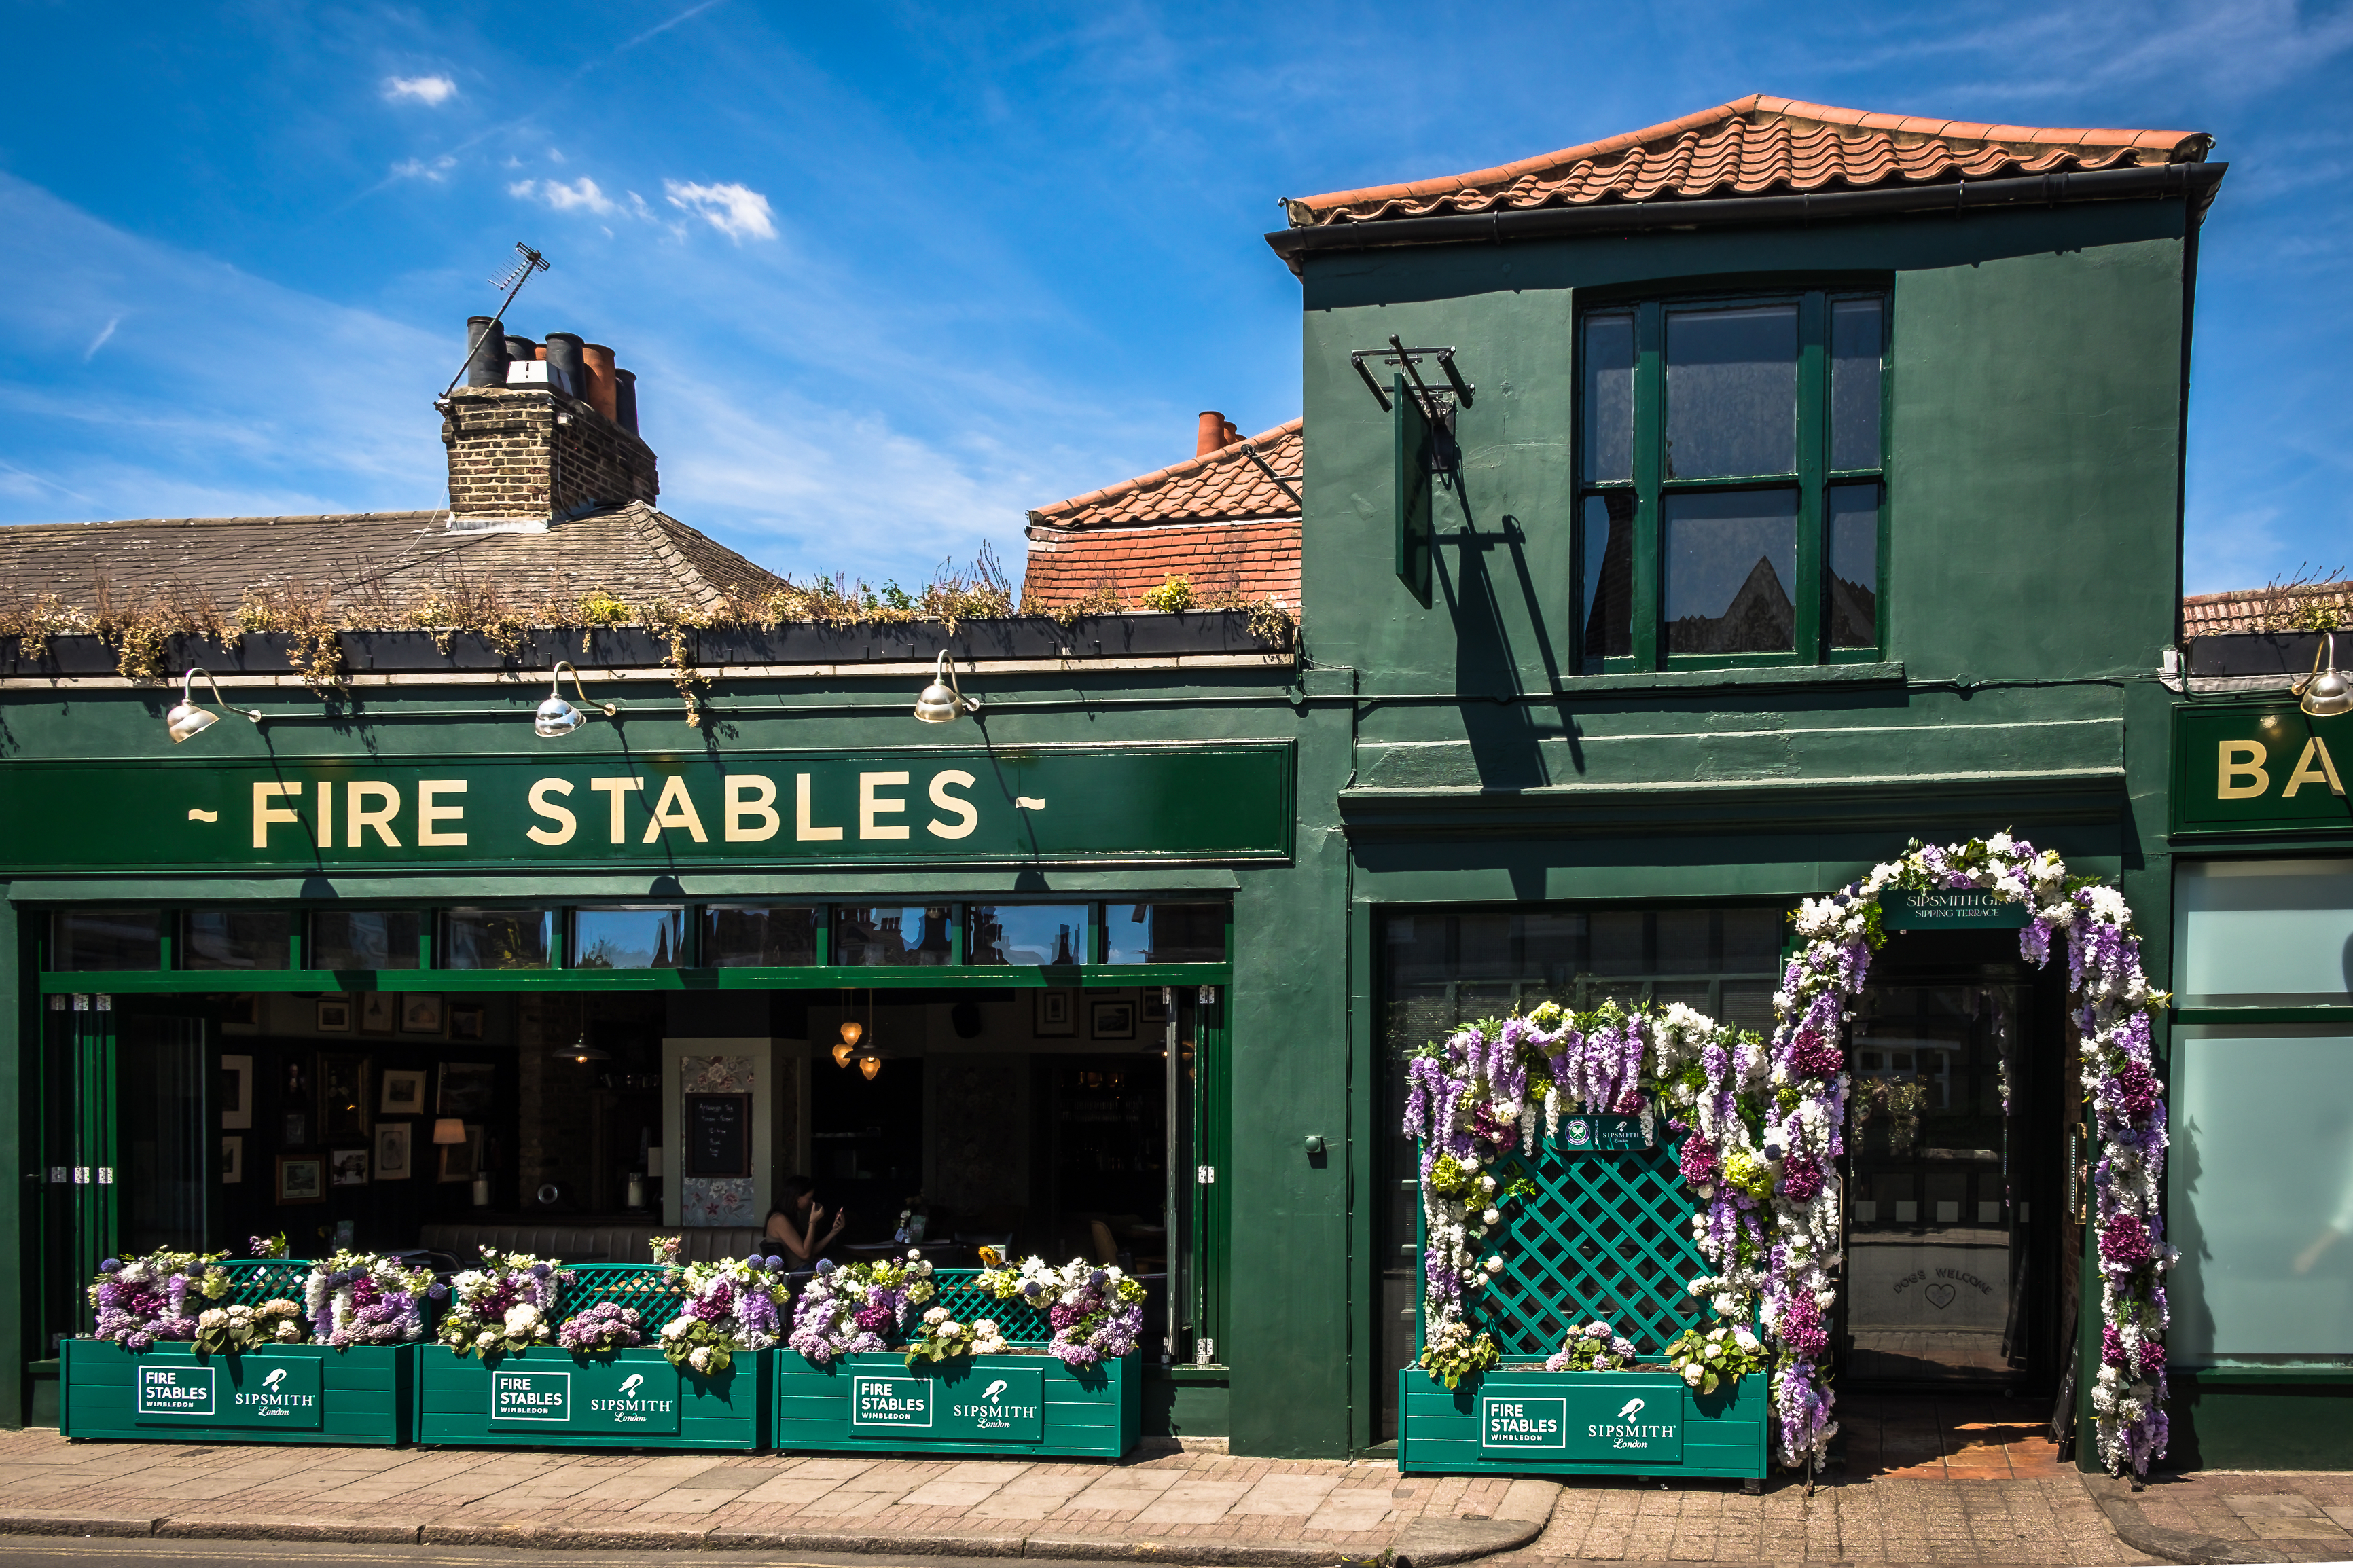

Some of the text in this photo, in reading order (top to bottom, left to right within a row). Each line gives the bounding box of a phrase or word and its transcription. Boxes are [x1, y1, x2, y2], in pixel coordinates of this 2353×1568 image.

[2218, 735, 2345, 799] BA
[253, 780, 467, 848] FIRE
[526, 770, 977, 845] STABLES
[1907, 894, 1979, 907] SIPSMITH
[1916, 909, 2000, 918] SIPPING TERRACE
[1893, 1268, 1993, 1295] DOGS WELCOME
[146, 1372, 176, 1384] FIRE
[501, 1379, 531, 1390] FIRE
[147, 1387, 207, 1399] STABLES
[862, 1383, 892, 1396] FIRE
[501, 1392, 562, 1405] STABLES
[862, 1398, 924, 1411] STABLES
[259, 1406, 289, 1416] London
[615, 1412, 647, 1422] London
[1491, 1404, 1523, 1417] FIRE
[977, 1418, 1010, 1428] London
[1491, 1419, 1557, 1432] STABLES
[1613, 1438, 1647, 1449] London
